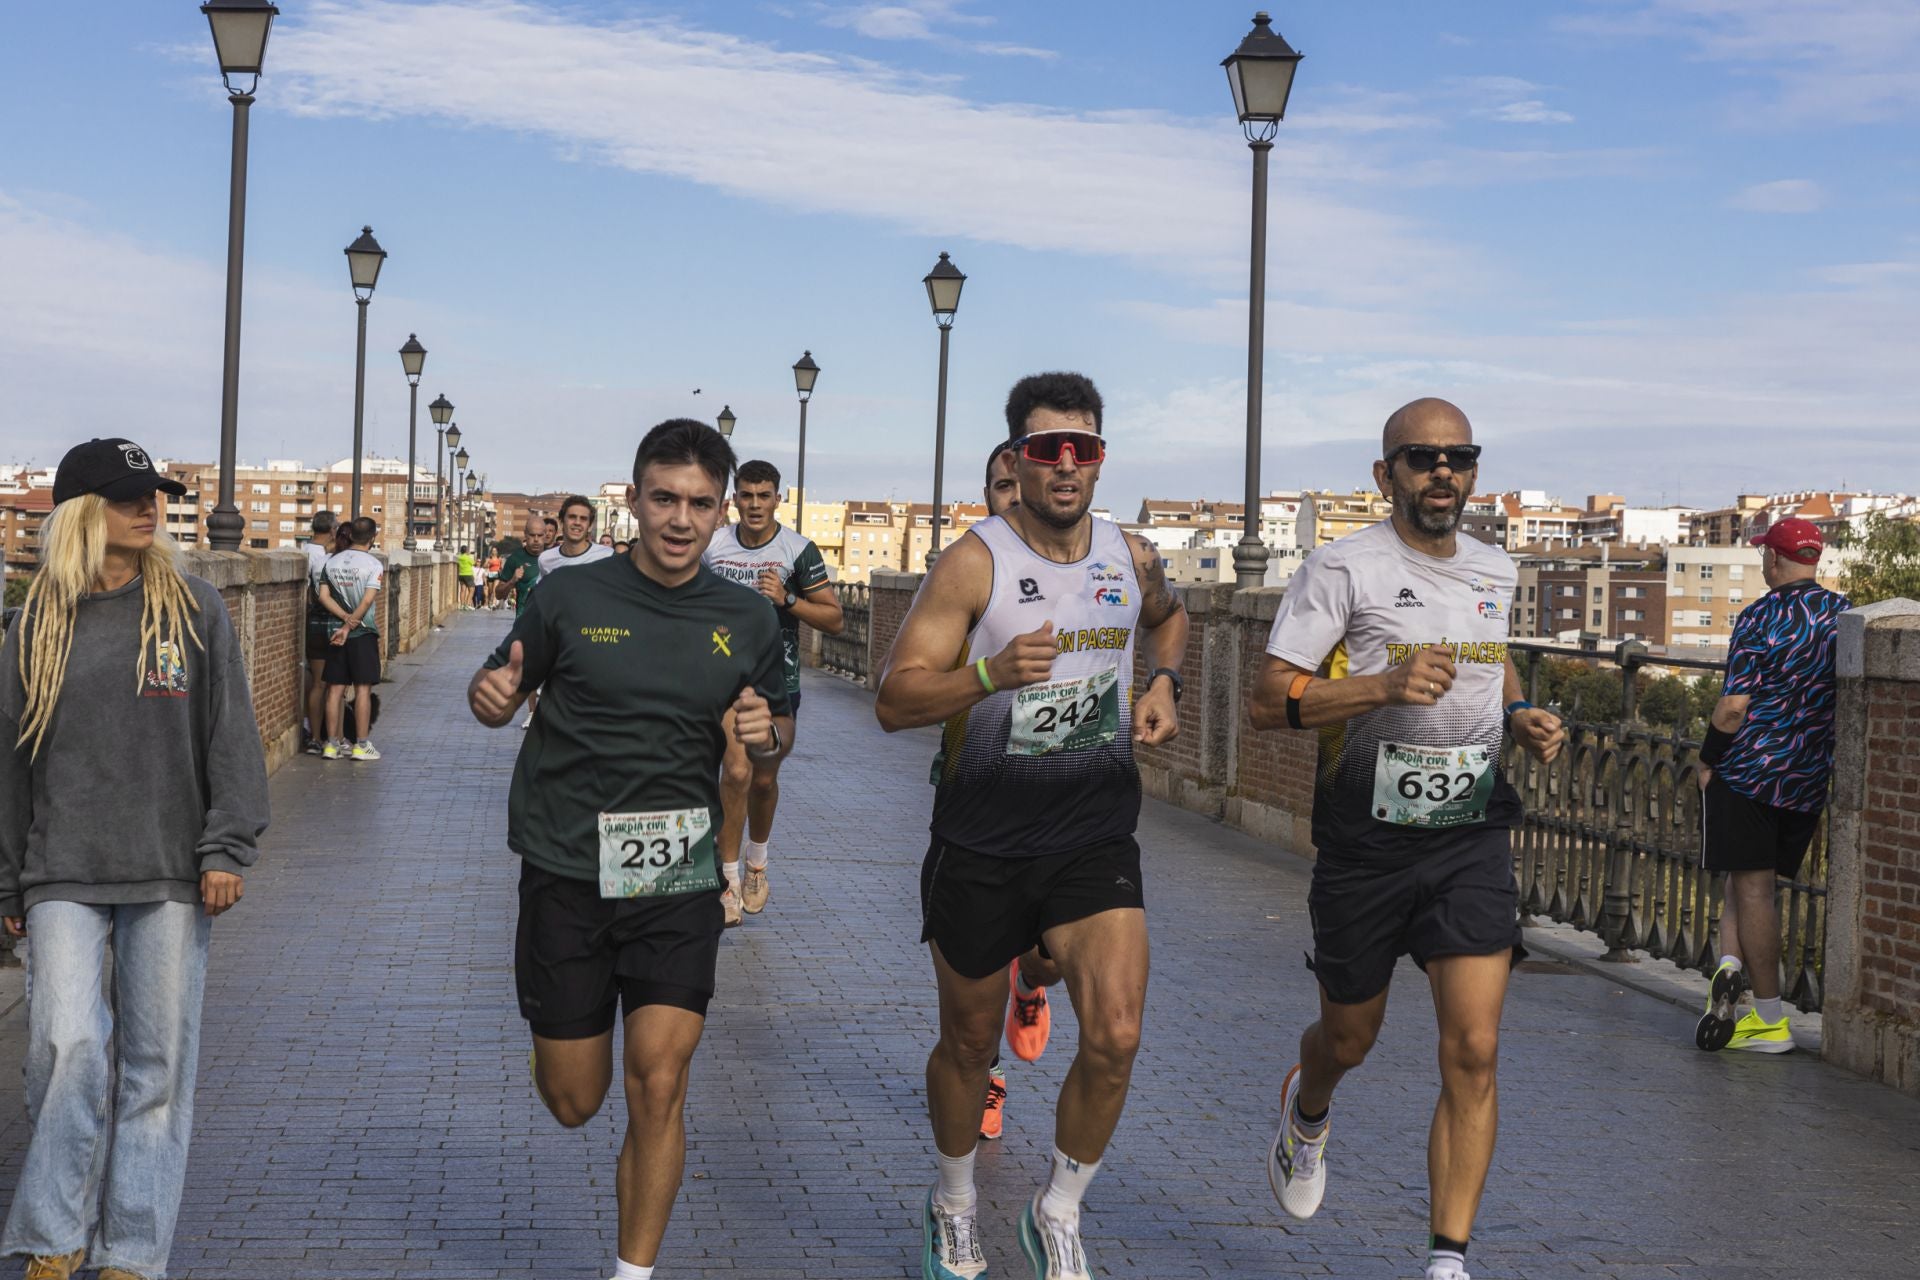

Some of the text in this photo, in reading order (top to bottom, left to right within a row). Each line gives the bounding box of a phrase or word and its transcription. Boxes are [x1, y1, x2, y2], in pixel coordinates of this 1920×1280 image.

[581, 627, 631, 637] GUARDIA
[591, 634, 619, 643] CIVIL
[1077, 627, 1132, 651] PACENS
[1018, 690, 1057, 706] GUARDIA
[1060, 686, 1080, 698] CIVIL
[1033, 693, 1100, 733] 242
[1426, 756, 1450, 766] CIVIL
[1398, 771, 1476, 802] 632
[604, 820, 669, 836] GUARDIA CIVIL
[620, 835, 694, 869] 231
